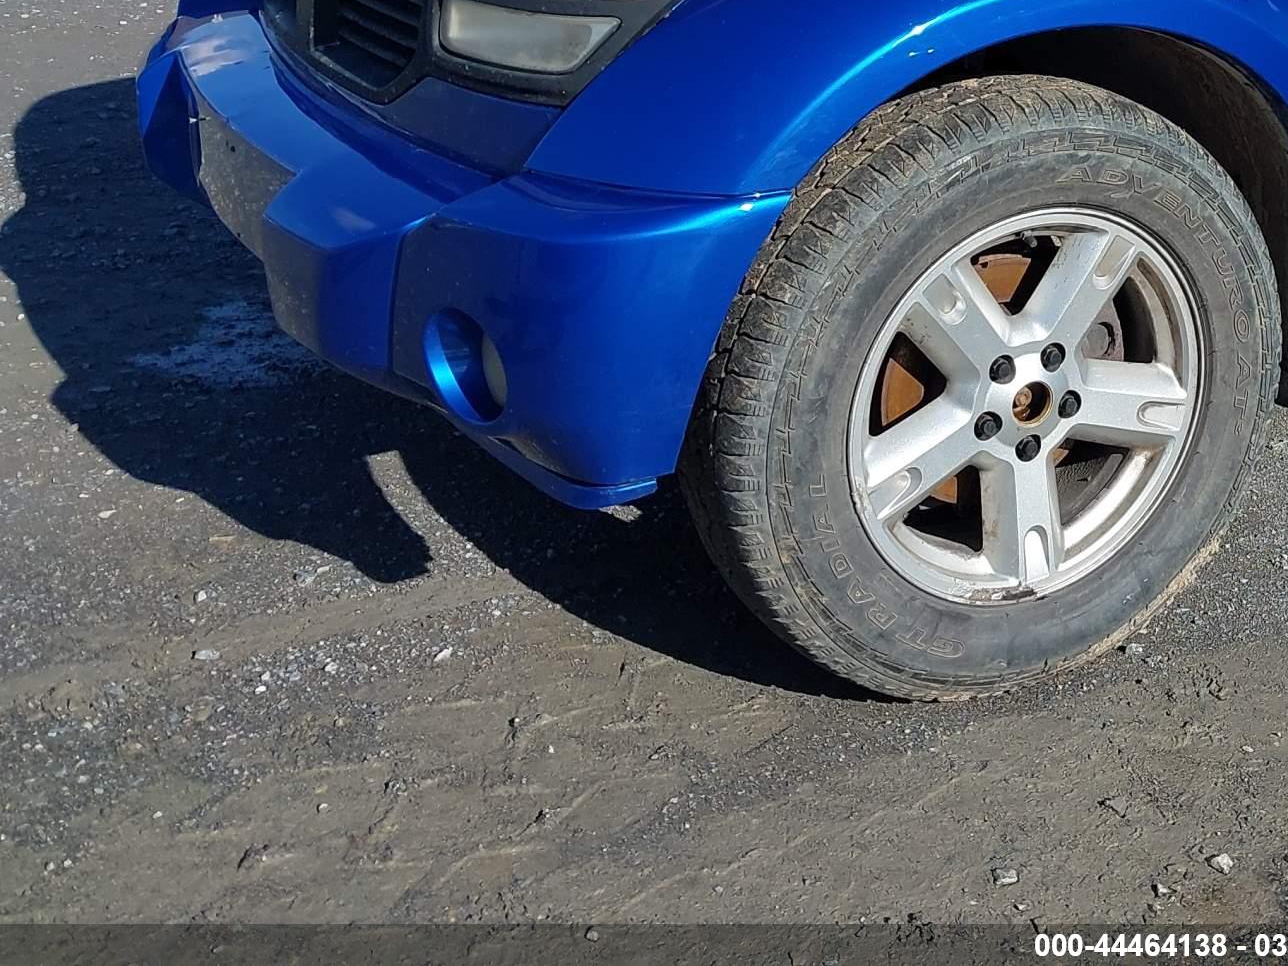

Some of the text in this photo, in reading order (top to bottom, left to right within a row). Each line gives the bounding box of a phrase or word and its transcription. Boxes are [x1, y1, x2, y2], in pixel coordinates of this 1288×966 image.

[1055, 165, 1250, 344] ADVENTURO
[809, 473, 966, 658] GT RADIAL
